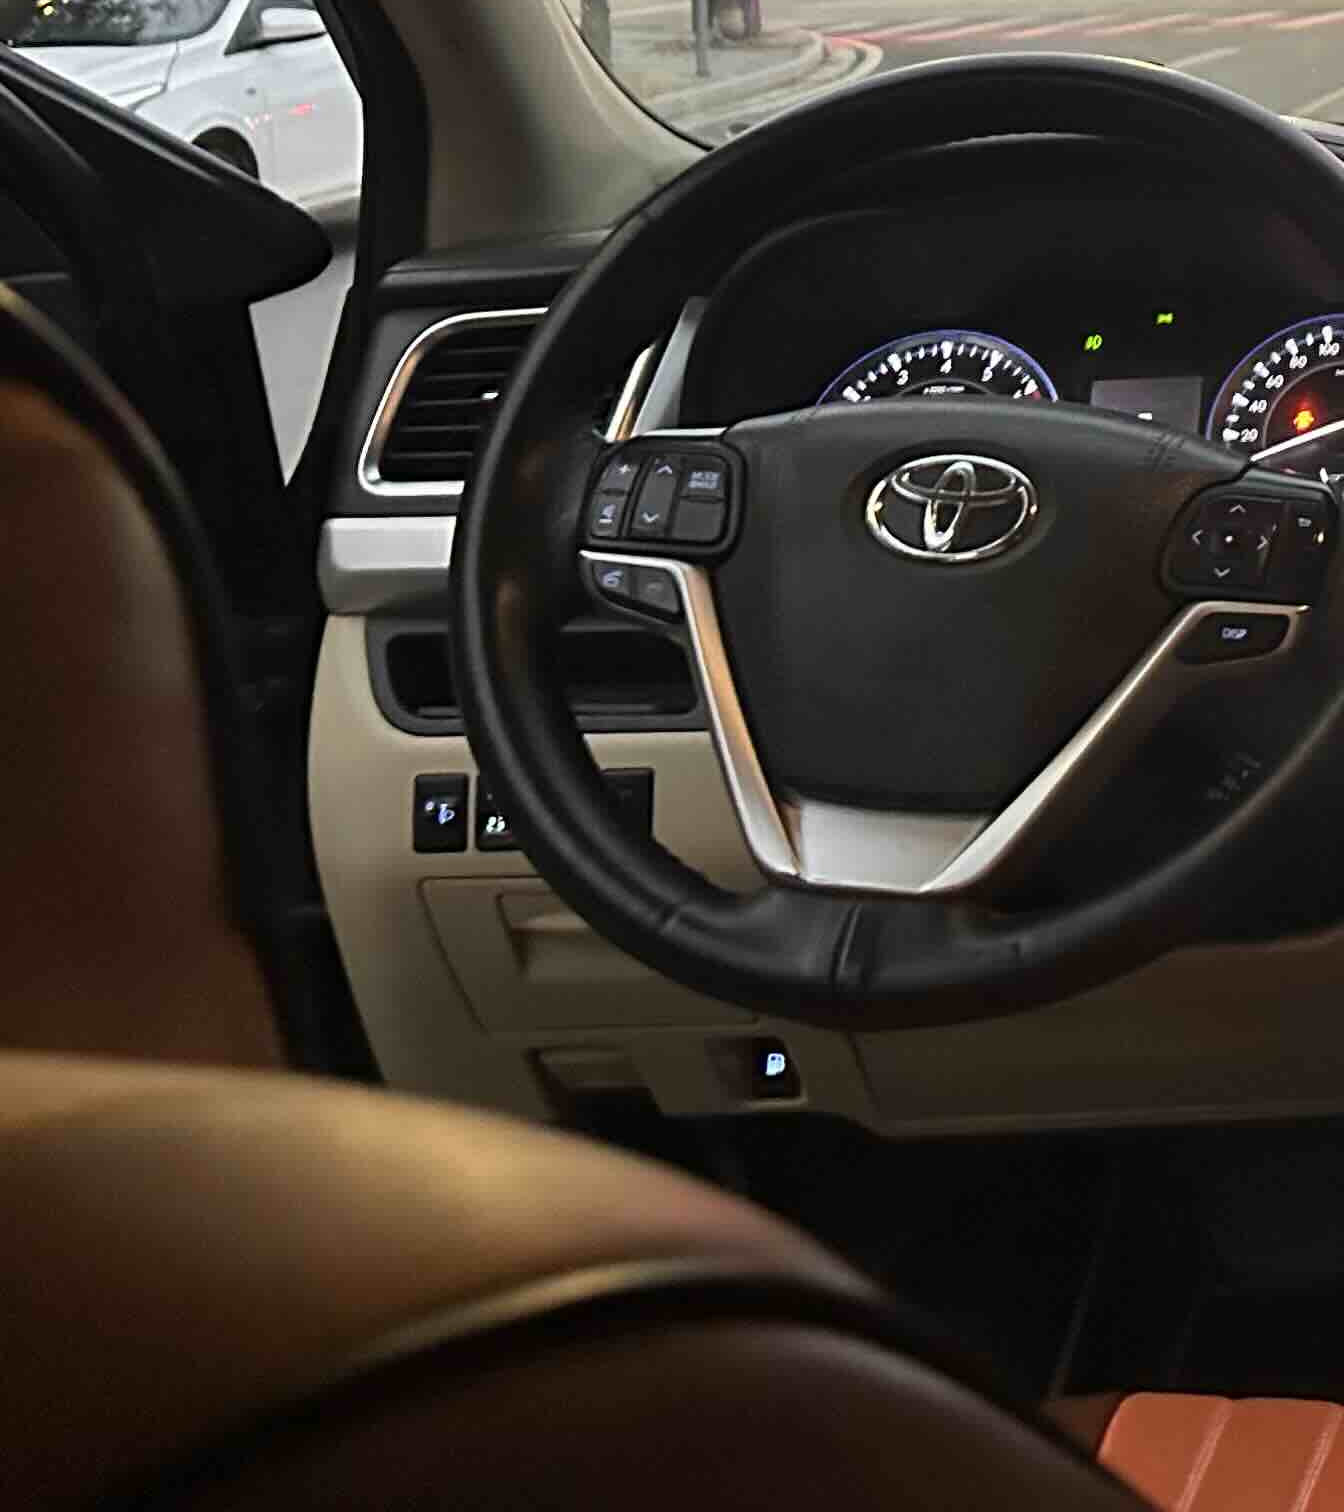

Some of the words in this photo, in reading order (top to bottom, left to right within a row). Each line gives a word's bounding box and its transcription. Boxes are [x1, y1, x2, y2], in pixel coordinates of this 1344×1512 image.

[939, 358, 953, 374] 4
[896, 369, 909, 386] 3
[1264, 374, 1284, 389] 60
[1248, 399, 1267, 413] 40
[1240, 428, 1259, 443] 20
